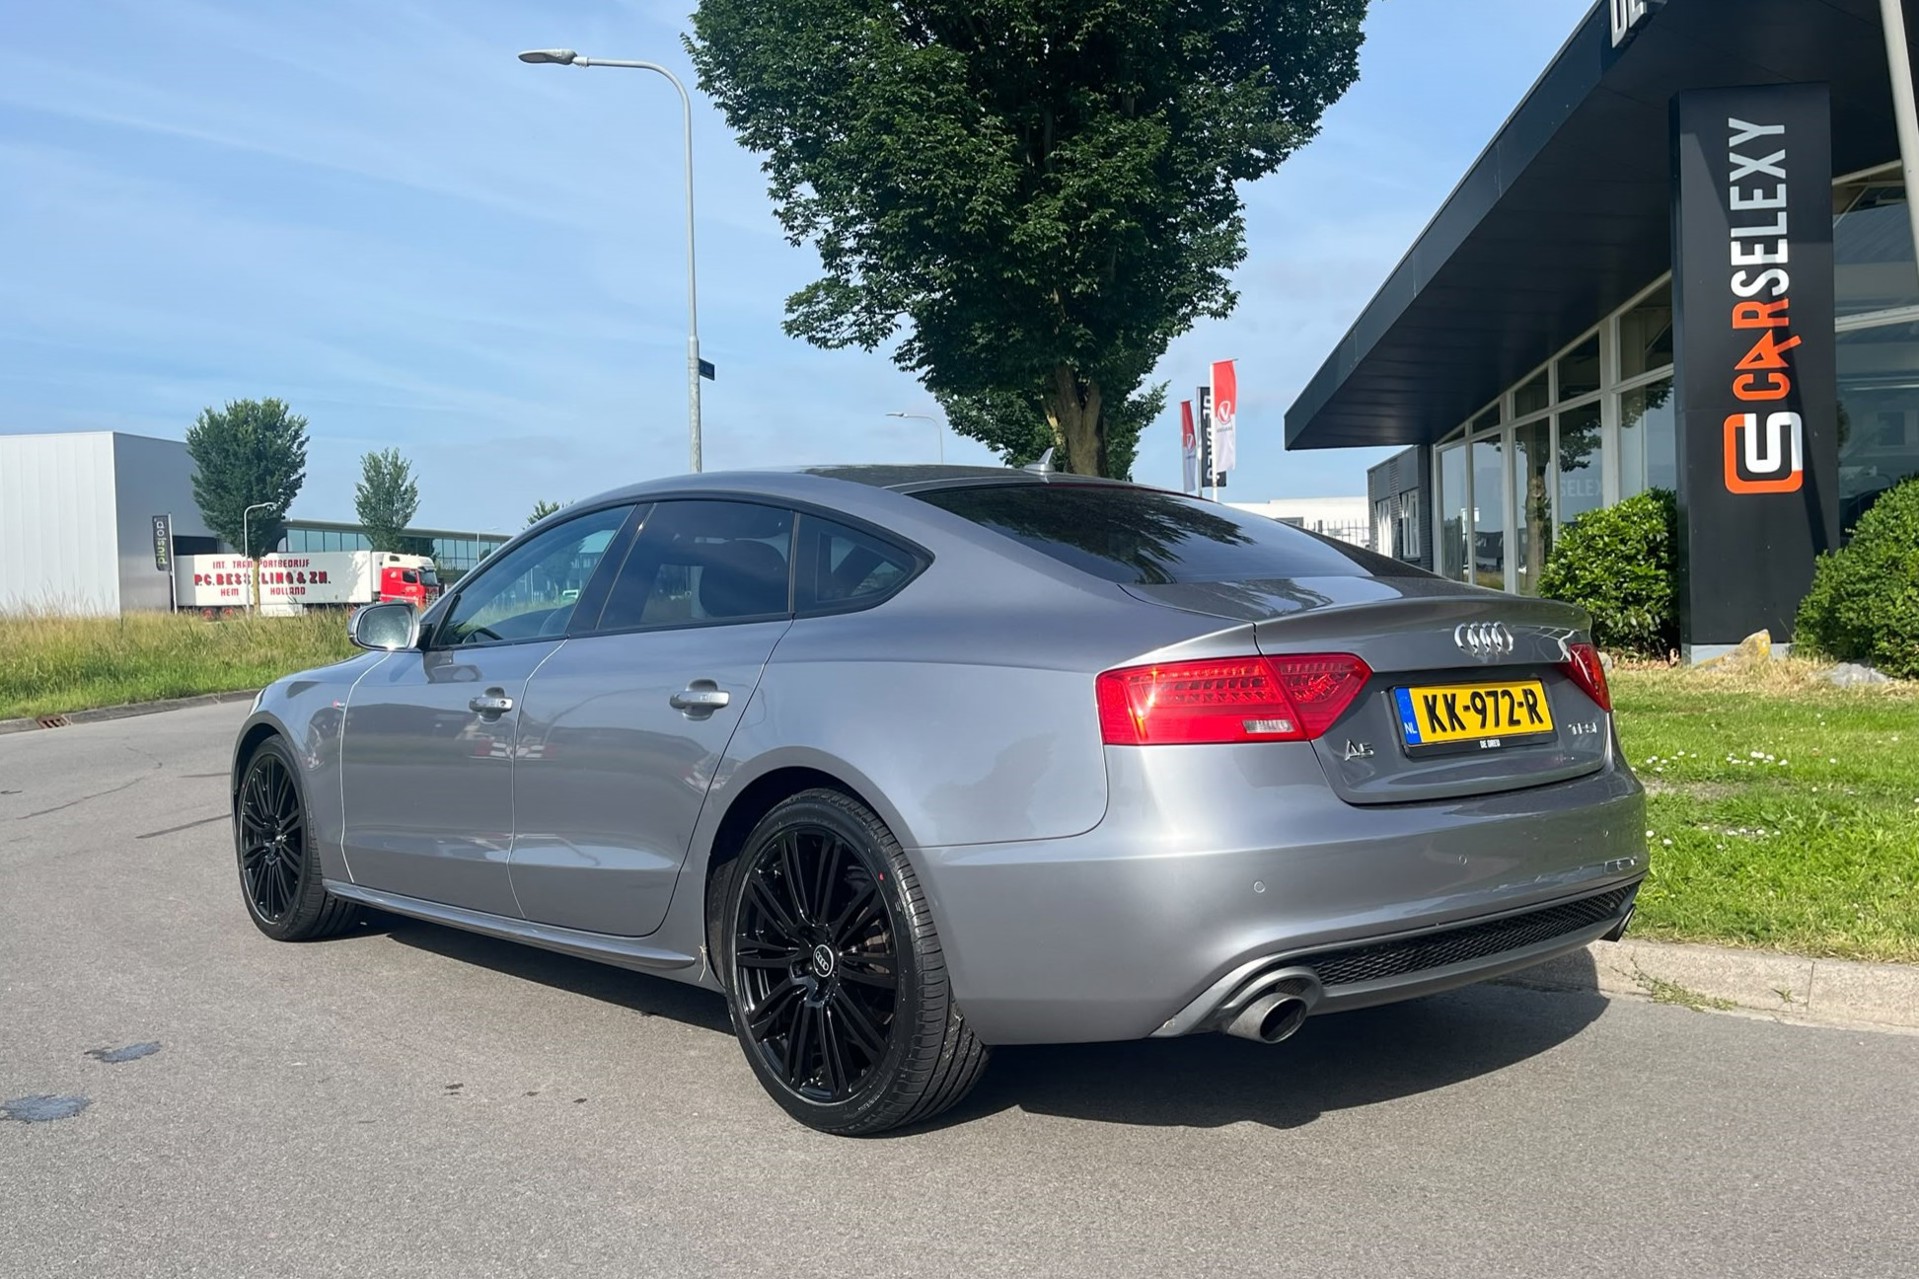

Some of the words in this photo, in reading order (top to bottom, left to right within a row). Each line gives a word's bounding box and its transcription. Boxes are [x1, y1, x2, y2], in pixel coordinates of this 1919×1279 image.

[1728, 117, 1802, 401] CARSELEXY
[220, 587, 239, 597] HEM
[270, 586, 306, 596] HOLLAND
[1422, 688, 1544, 734] KK-972-R
[1404, 722, 1418, 734] NL
[1344, 738, 1375, 761] A5
